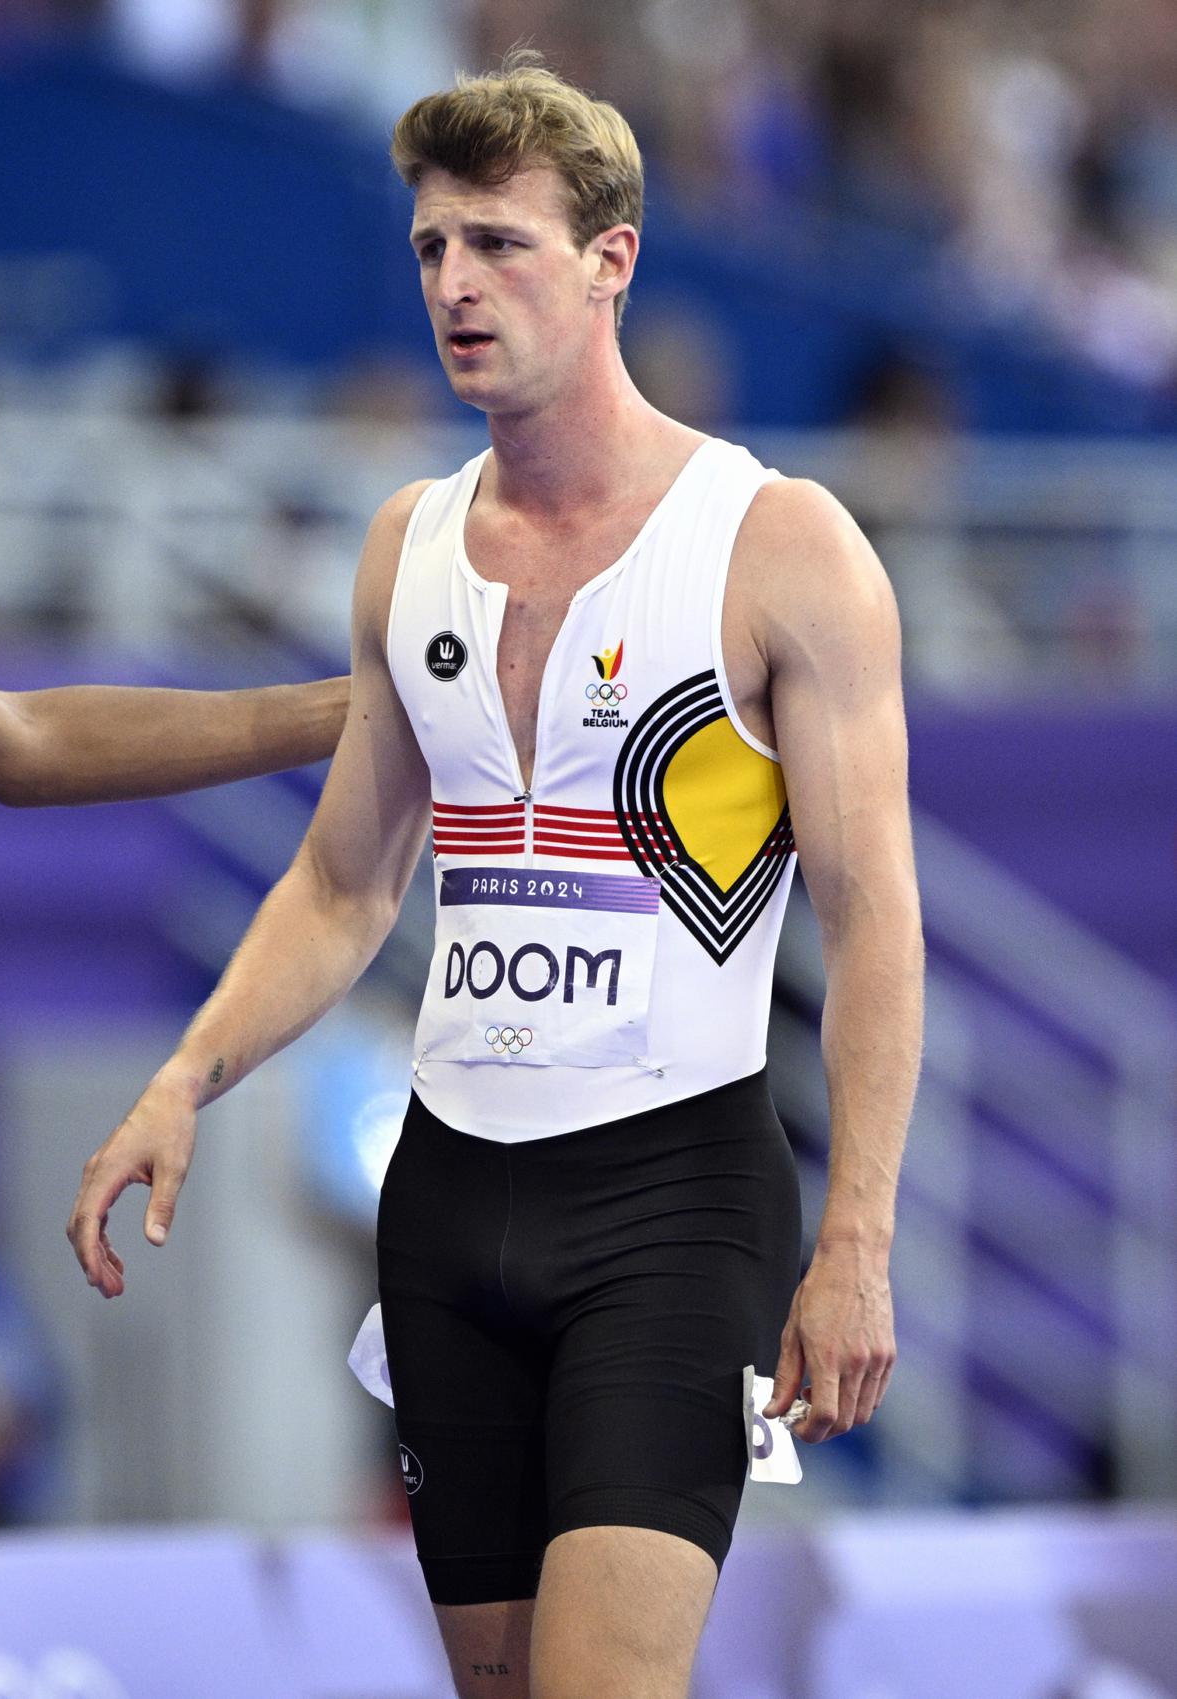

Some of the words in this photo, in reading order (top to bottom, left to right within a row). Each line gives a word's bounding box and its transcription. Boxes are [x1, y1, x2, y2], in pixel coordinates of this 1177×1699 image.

[591, 709, 620, 718] TEAM
[582, 718, 629, 728] BELGIUM
[527, 880, 583, 899] 2024
[444, 940, 622, 1006] DOOM
